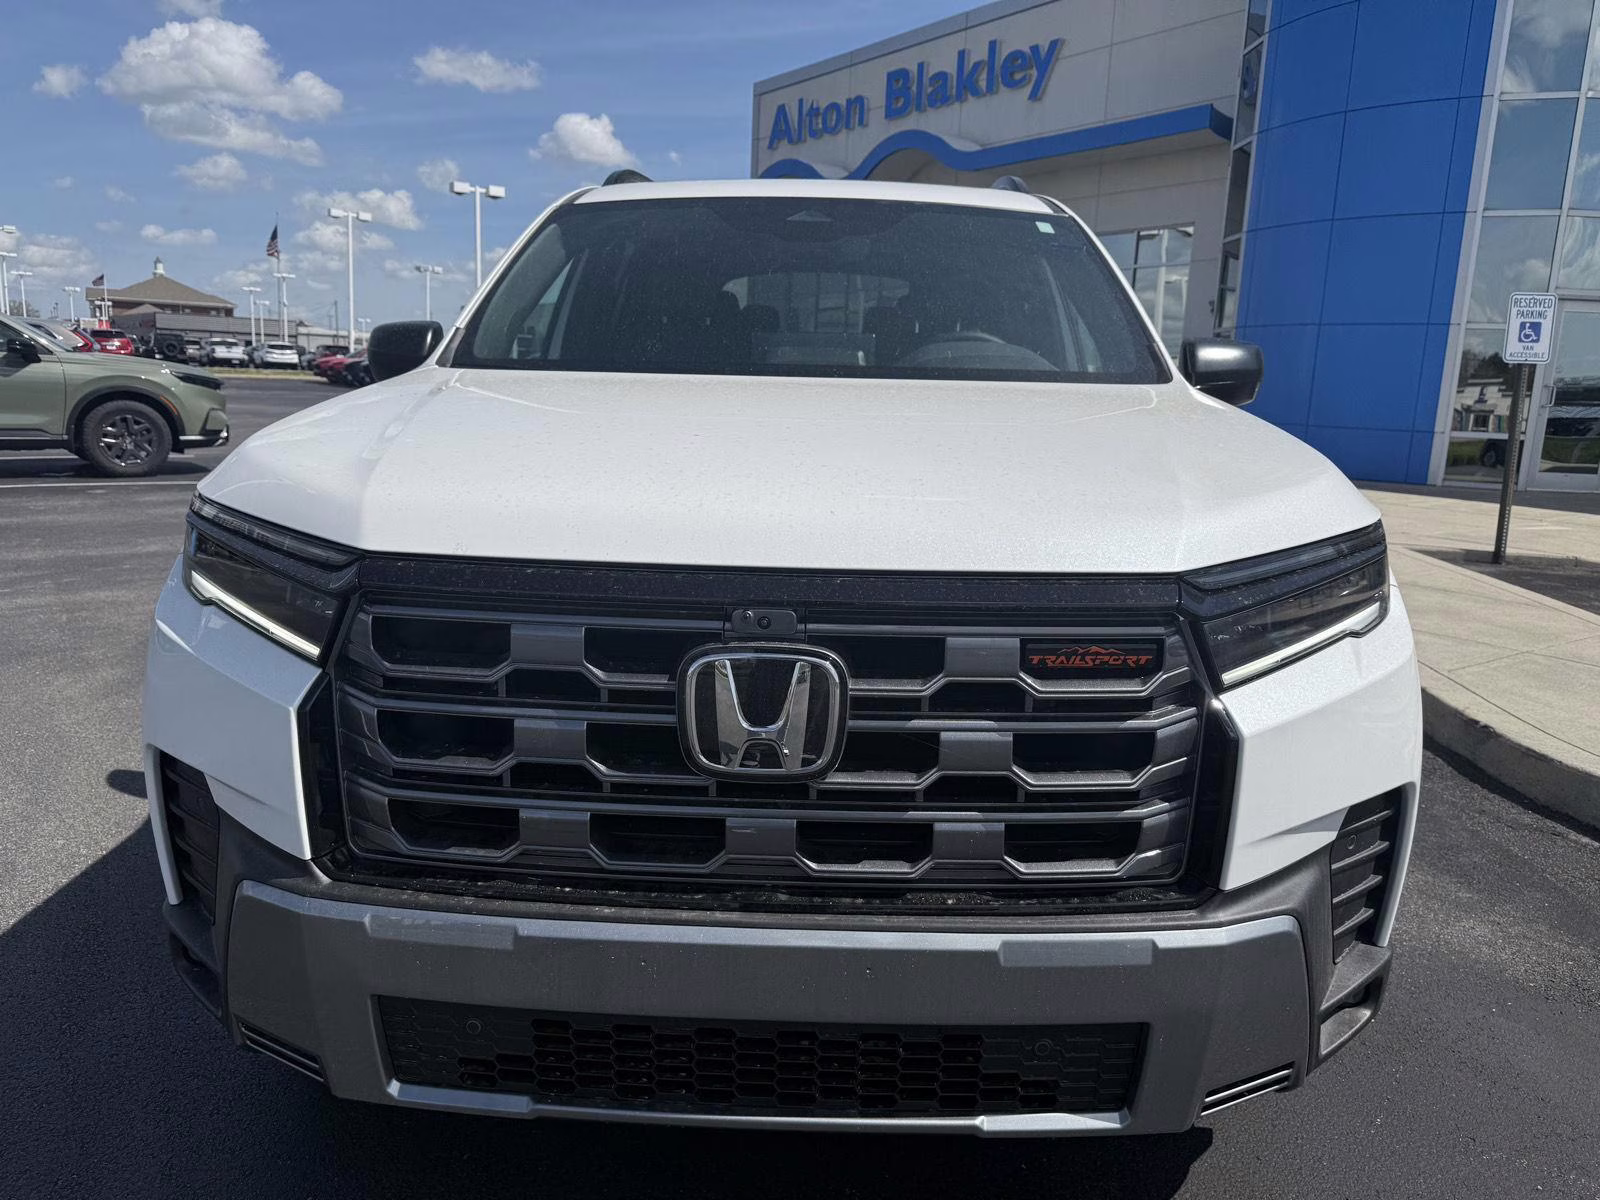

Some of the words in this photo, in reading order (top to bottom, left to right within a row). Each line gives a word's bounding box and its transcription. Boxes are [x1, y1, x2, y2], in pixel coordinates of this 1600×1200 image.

[767, 94, 868, 150] Alton
[884, 37, 1063, 120] Blakley
[1513, 297, 1553, 308] RESERVED
[1516, 310, 1548, 319] PARKING
[1029, 655, 1153, 667] TRAILSPORT
